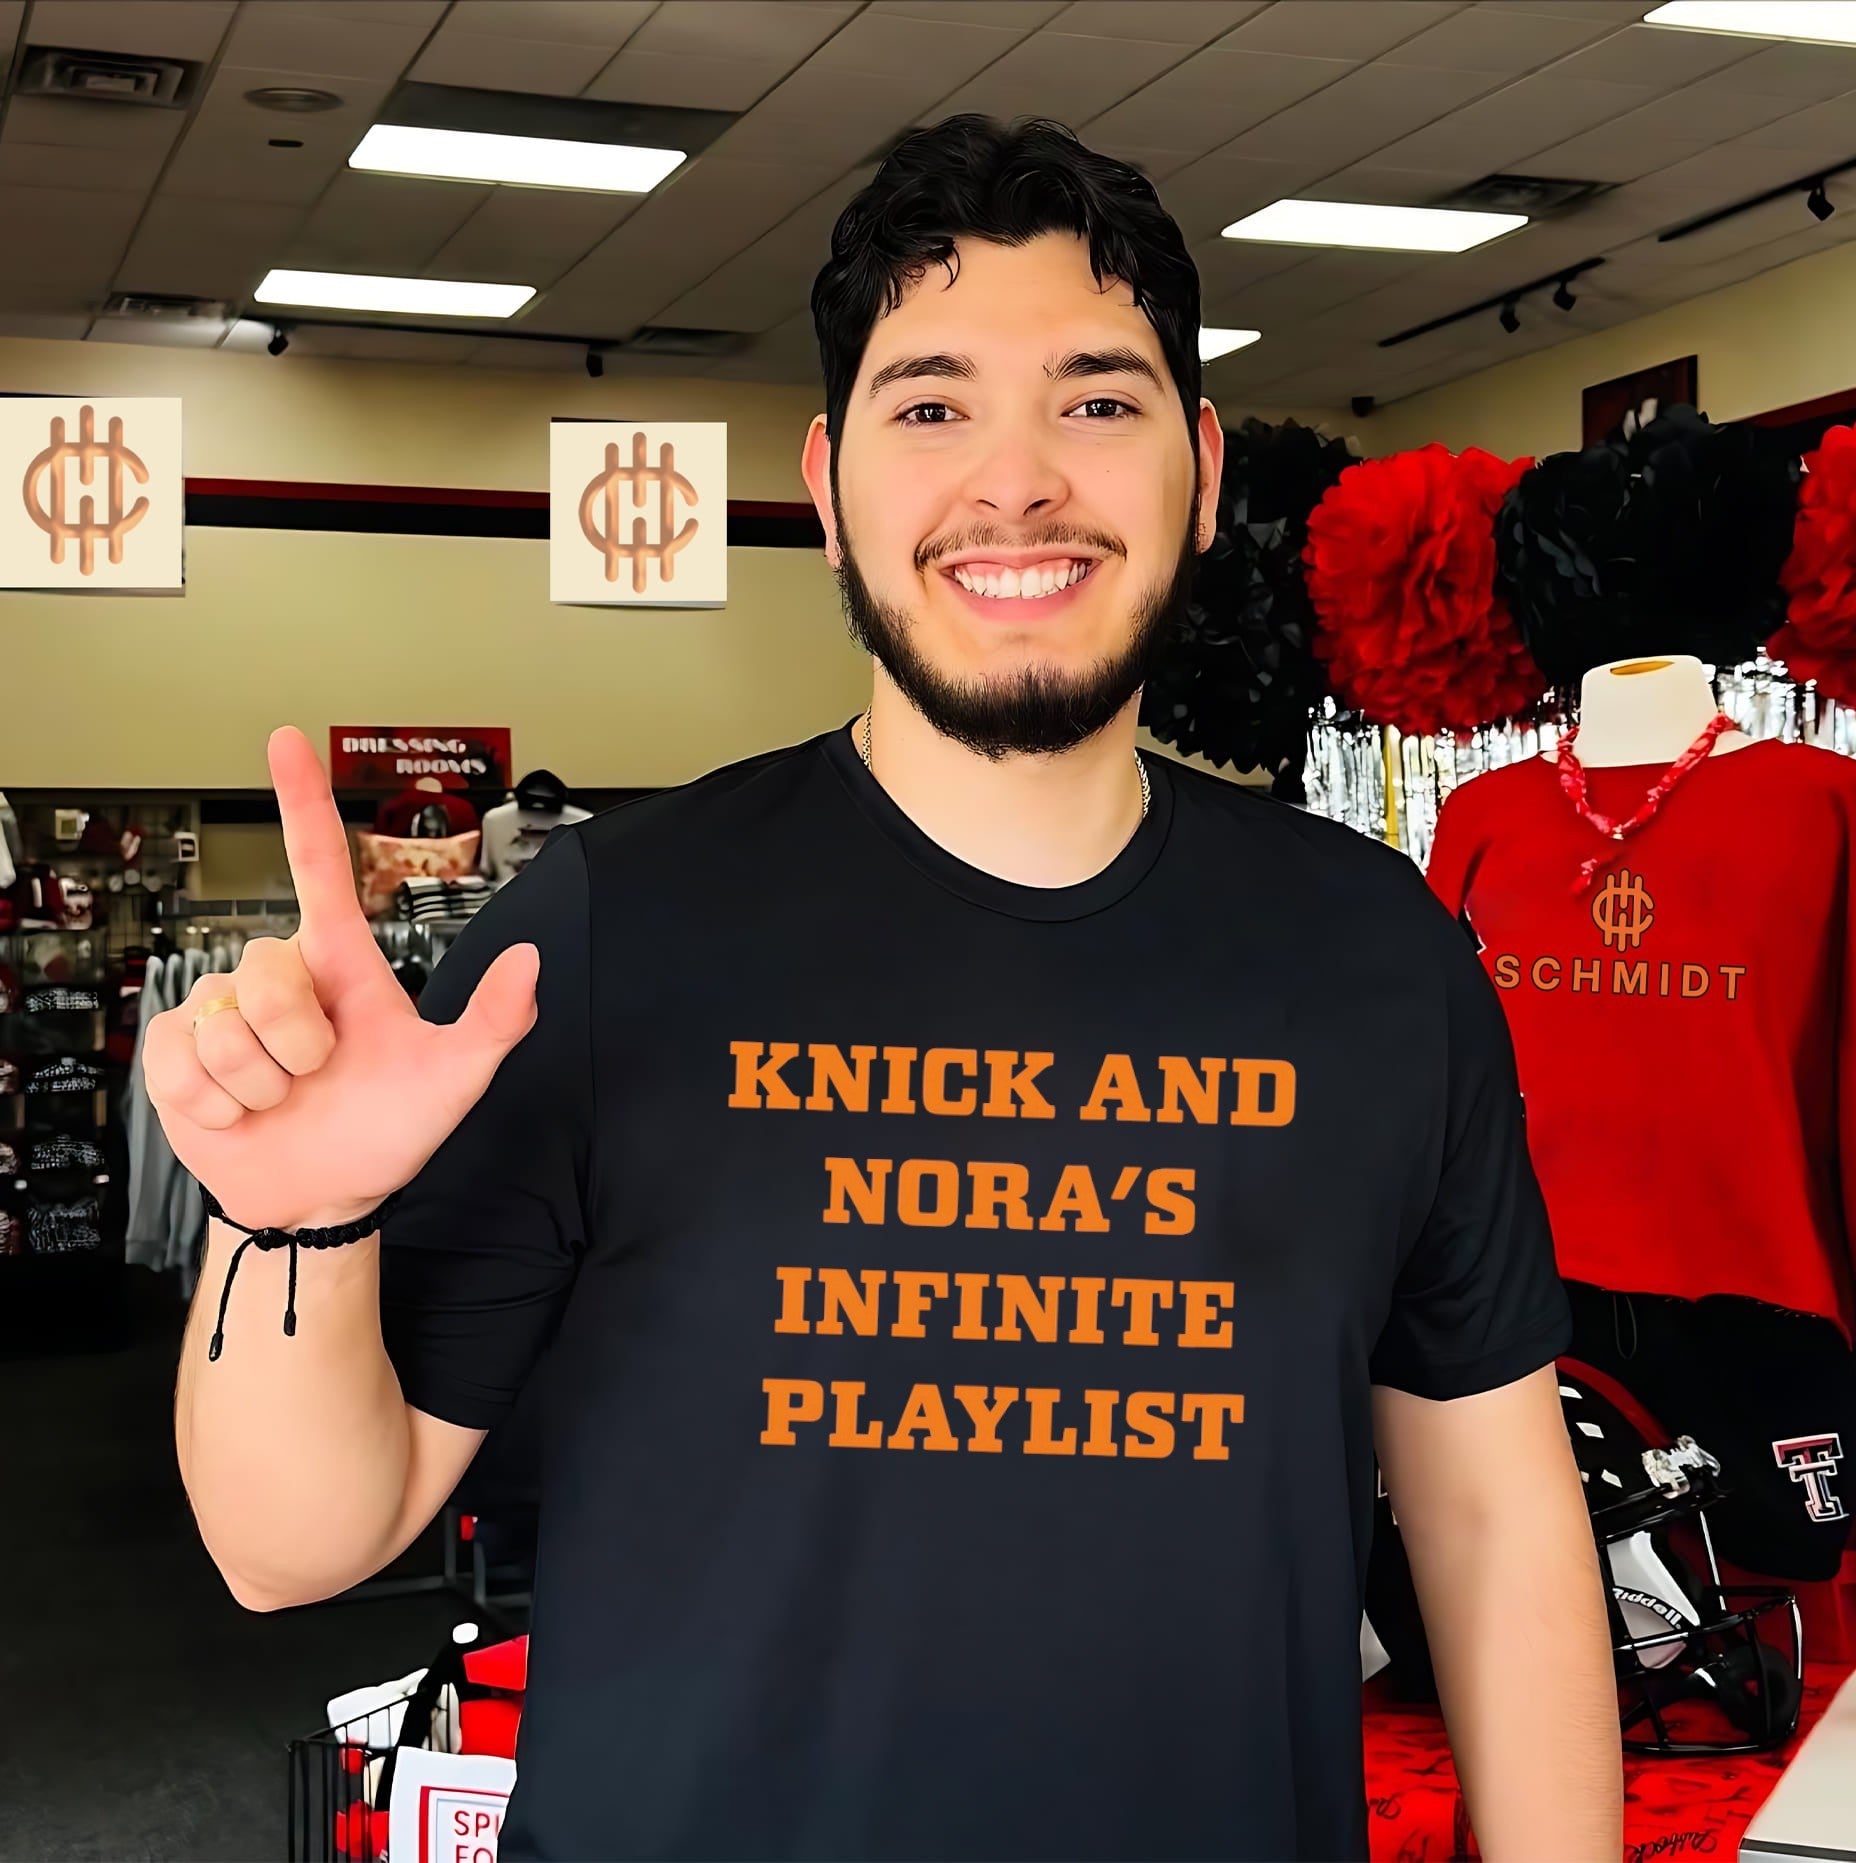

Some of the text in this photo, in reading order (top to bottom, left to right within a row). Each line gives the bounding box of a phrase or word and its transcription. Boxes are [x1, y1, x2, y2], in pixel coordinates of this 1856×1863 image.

[342, 737, 467, 754] DRESSING
[396, 758, 487, 775] ROOMS
[1494, 953, 1747, 1001] SCHMIDT
[728, 1041, 1296, 1127] KNICK AND
[823, 1157, 1196, 1236] NORA'S
[774, 1266, 1235, 1349] INFINITE
[760, 1378, 1245, 1460] PLAYLIST
